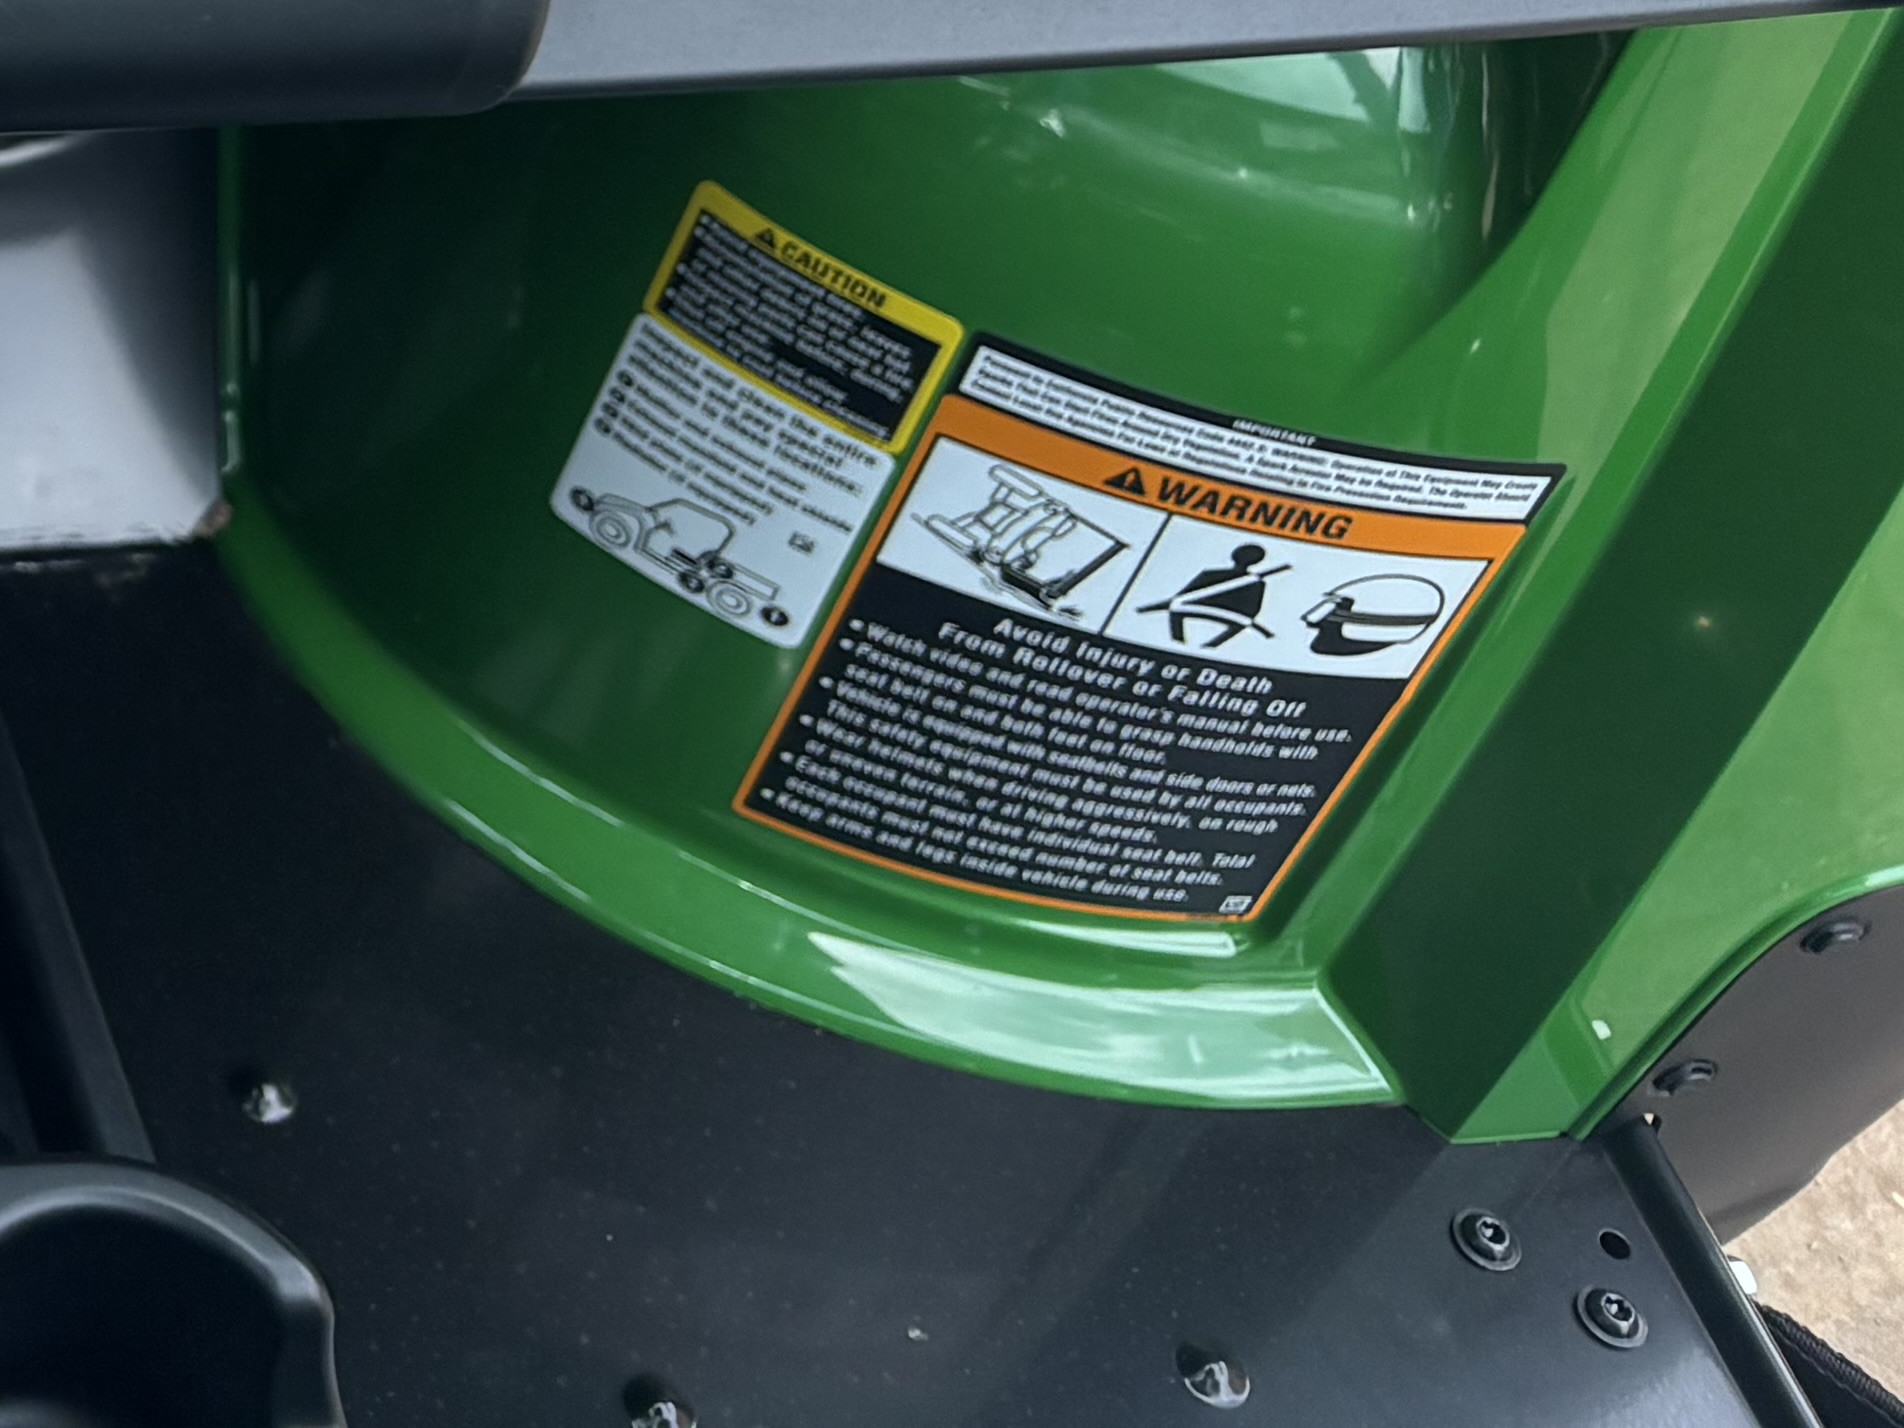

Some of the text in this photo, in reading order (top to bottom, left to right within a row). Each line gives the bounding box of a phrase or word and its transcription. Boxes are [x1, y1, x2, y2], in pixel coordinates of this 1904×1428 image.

[781, 239, 887, 309] CAUTION
[1158, 476, 1353, 540] WARNING
[867, 622, 1352, 743] Watch video and read operator's manual before use.
[939, 621, 1307, 720] From Rollover or Falling Off
[993, 618, 1273, 694] Avoid Injury or Death
[844, 663, 1167, 765] seat belt on and both feet on floor.
[855, 641, 1319, 760] Passengers must be able to grasp handholds with
[804, 739, 829, 757] or
[975, 795, 999, 812] or
[999, 801, 1023, 819] at
[1023, 805, 1087, 831] higher
[868, 718, 929, 749] safety
[929, 739, 1032, 779] equipment
[1032, 768, 1082, 789] must
[1082, 777, 1108, 795] be
[1109, 784, 1157, 804] used
[1158, 790, 1183, 808] by
[1184, 794, 1213, 811] all
[1214, 799, 1307, 816] occupants.
[947, 766, 999, 790] when
[1000, 780, 1070, 811] driving
[1198, 816, 1223, 831] on
[1225, 818, 1279, 836] rough
[1006, 740, 1047, 759] with
[1047, 750, 1129, 779] seatbelts
[1129, 767, 1167, 784] and
[1166, 772, 1204, 790] side
[1205, 776, 1254, 795] doors
[1256, 782, 1277, 796] or
[1277, 783, 1316, 798] nets.
[825, 812, 874, 841] arms
[876, 830, 914, 853] and
[916, 839, 958, 864] legs
[959, 852, 1019, 879] inside
[1021, 869, 1089, 893] vehicle
[1090, 879, 1151, 901] during
[1152, 888, 1189, 902] use.
[881, 810, 930, 836] must
[931, 825, 965, 844] not
[965, 835, 1035, 862] exceed
[1035, 851, 1108, 875] number
[1108, 863, 1132, 878] of
[1131, 867, 1173, 883] seat
[1174, 869, 1223, 886] belts.
[928, 804, 977, 828] must
[977, 815, 1025, 839] have
[1027, 828, 1120, 856] individual
[1120, 846, 1163, 863] seat
[1212, 852, 1256, 868] Total
